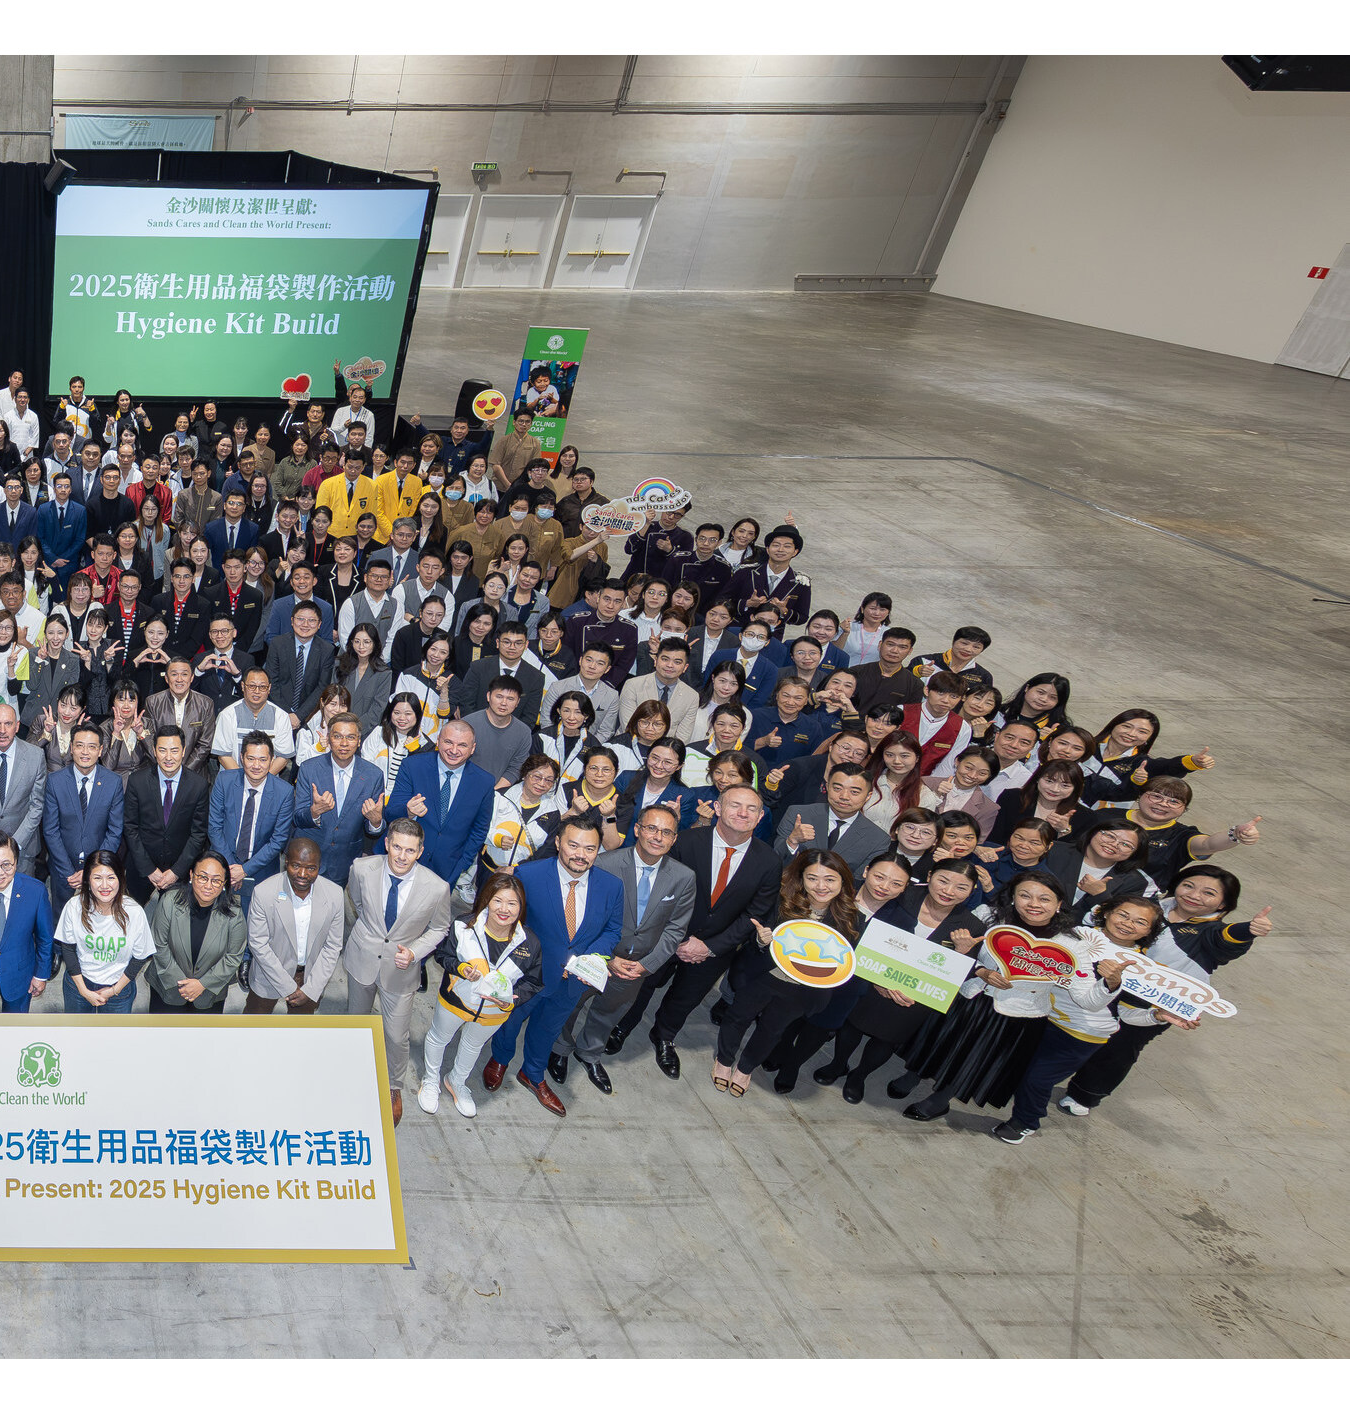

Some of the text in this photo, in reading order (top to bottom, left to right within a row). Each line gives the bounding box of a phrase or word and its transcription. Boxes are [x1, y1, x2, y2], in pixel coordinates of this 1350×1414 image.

[166, 196, 317, 215] 金沙關懷及潔世呈獻:
[147, 219, 332, 230] Sands Cares and Clean the World Present:
[69, 273, 396, 301] 2025衛生用品福袋製作活動
[115, 311, 341, 340] Hygiene Kit Build
[626, 488, 681, 504] nds Cares
[595, 509, 634, 520] Sands Cares
[85, 934, 127, 953] SOAP
[93, 950, 118, 963] GURU
[1115, 951, 1230, 1015] Sands
[1122, 978, 1198, 1017] 金沙關懷
[32, 1092, 50, 1105] the
[5, 1178, 103, 1199] Present:
[109, 1178, 167, 1200] 2025
[173, 1178, 270, 1205] Hygiene
[276, 1178, 310, 1200] Kit
[317, 1178, 377, 1201] Build
